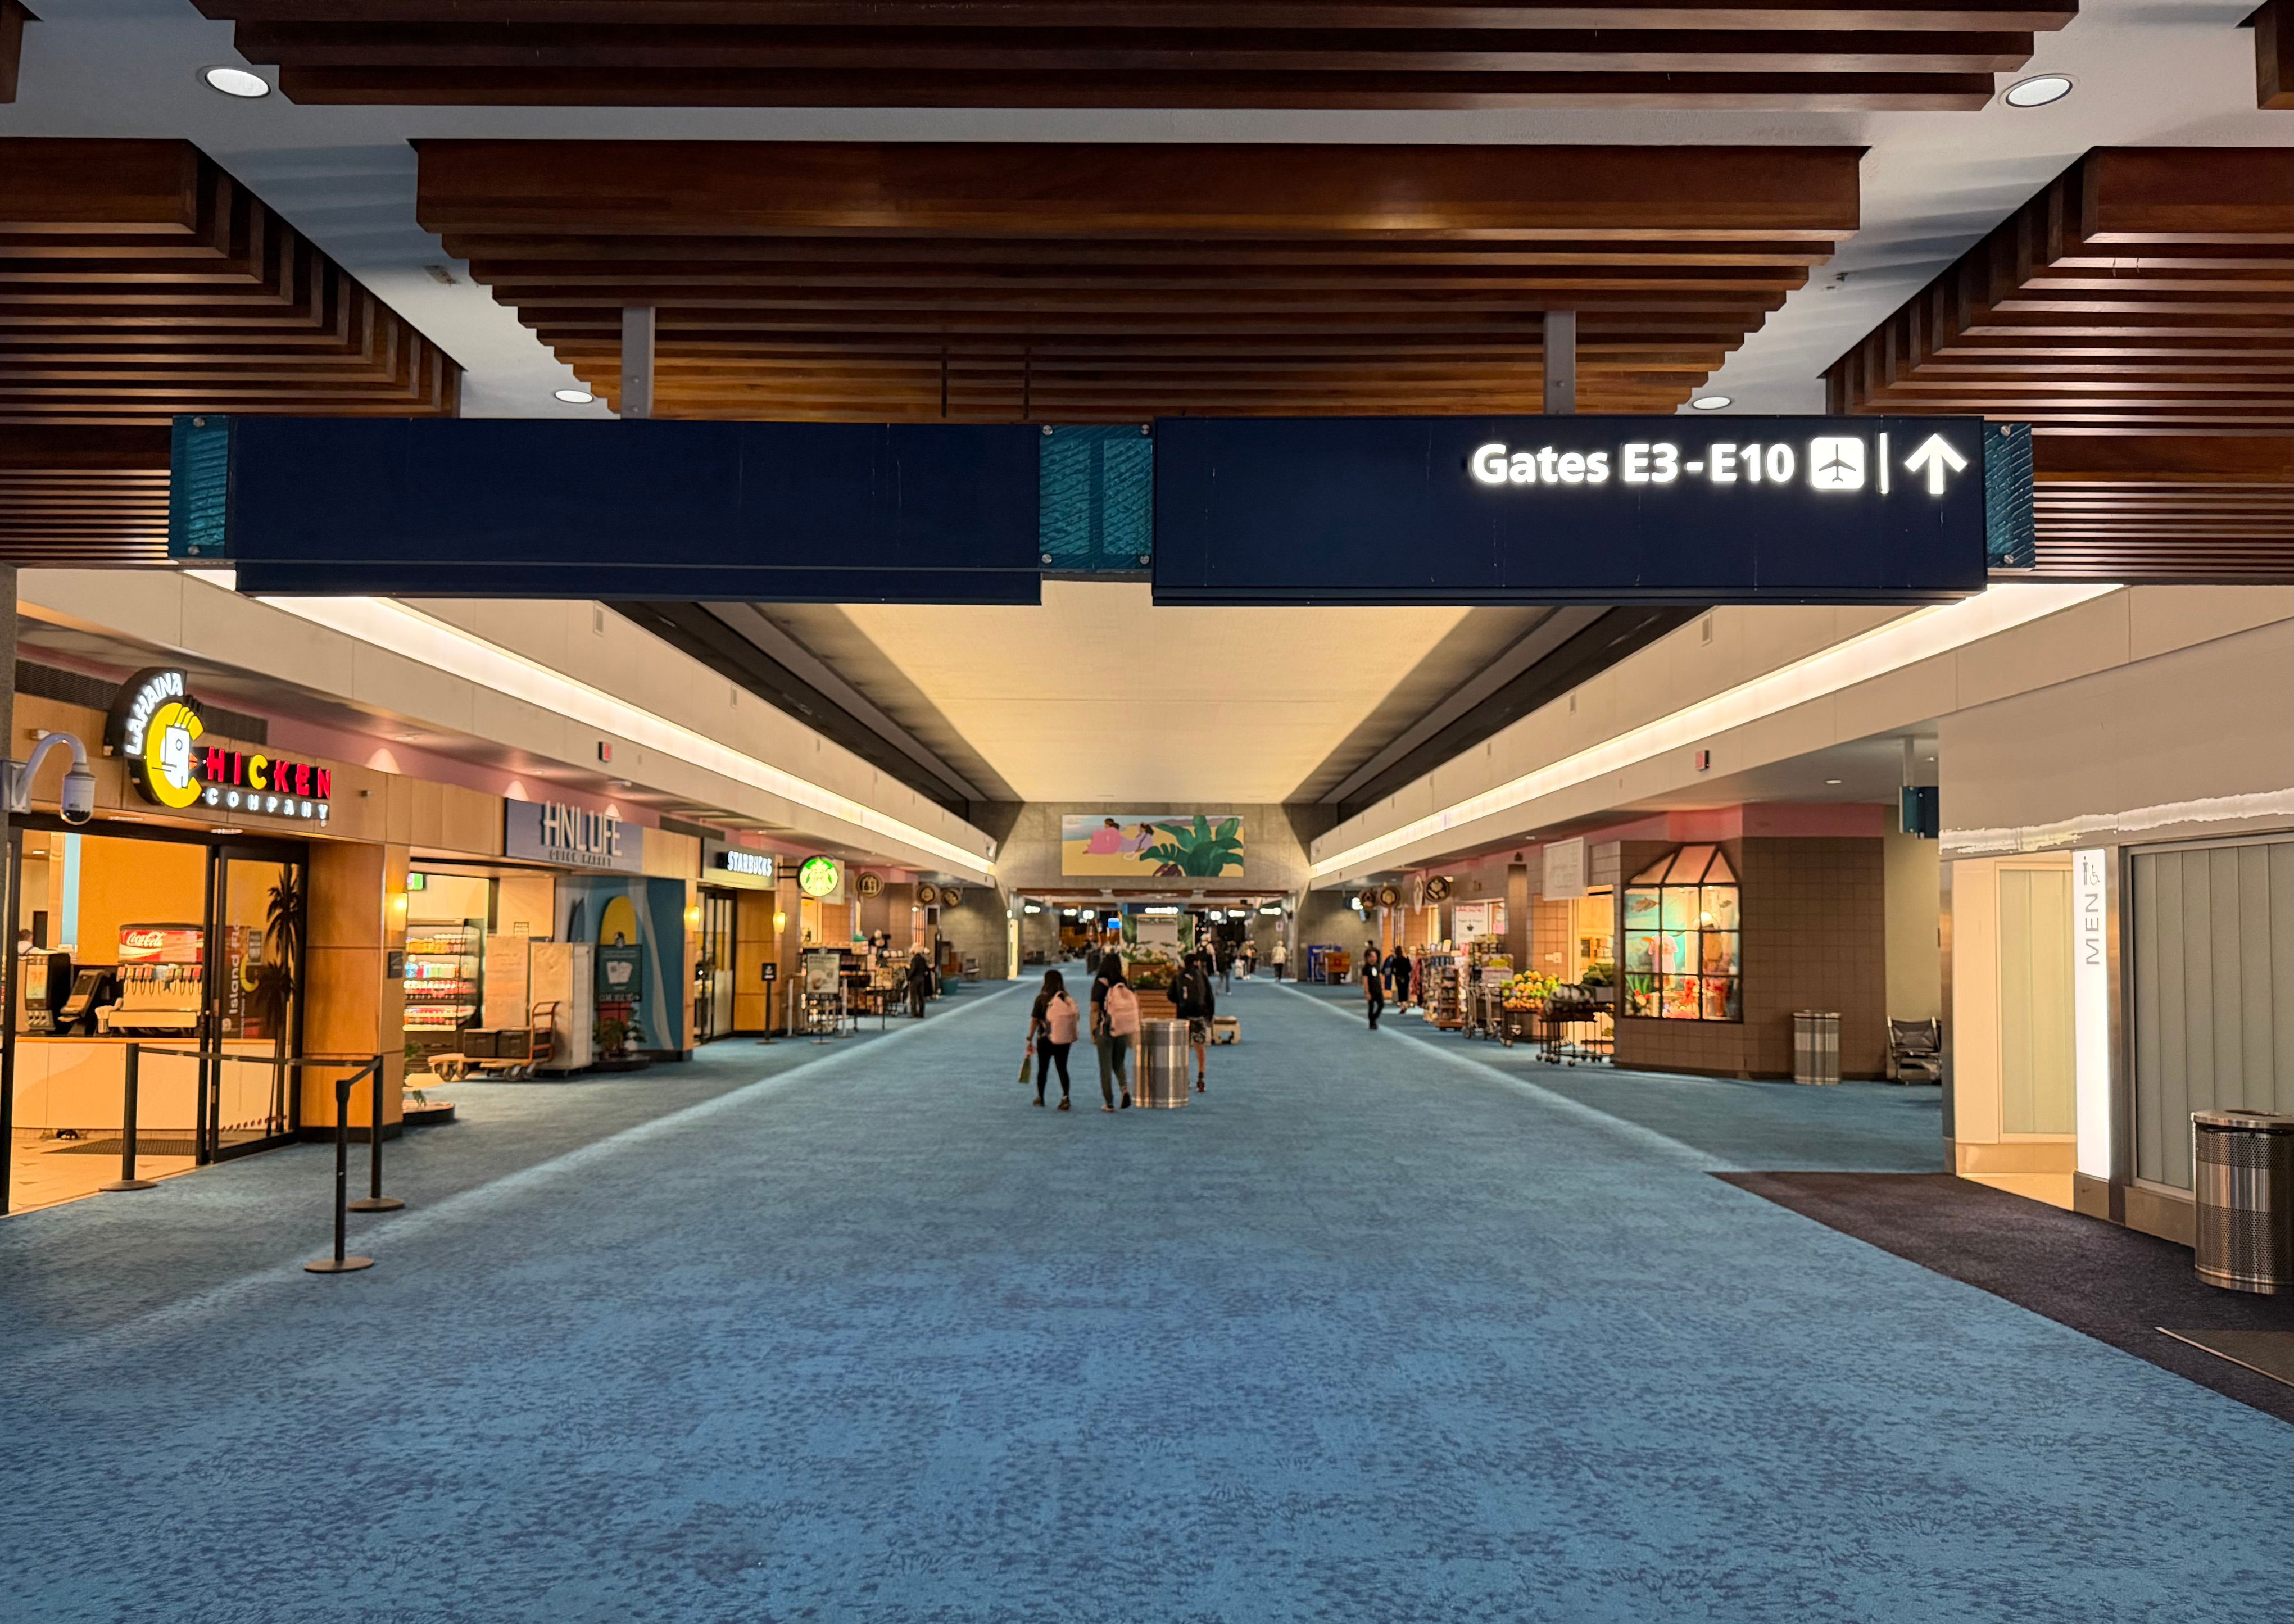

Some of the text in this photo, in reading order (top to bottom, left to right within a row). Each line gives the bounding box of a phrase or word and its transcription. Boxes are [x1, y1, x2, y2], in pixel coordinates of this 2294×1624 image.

[1472, 443, 1610, 483] Gates
[126, 673, 183, 755] LAHAINA
[206, 788, 328, 819] COMPANY
[543, 800, 623, 856] HNL LIFE
[727, 850, 772, 877] STARBUCKS
[2084, 893, 2100, 965] MEN
[229, 954, 240, 1014] Island
